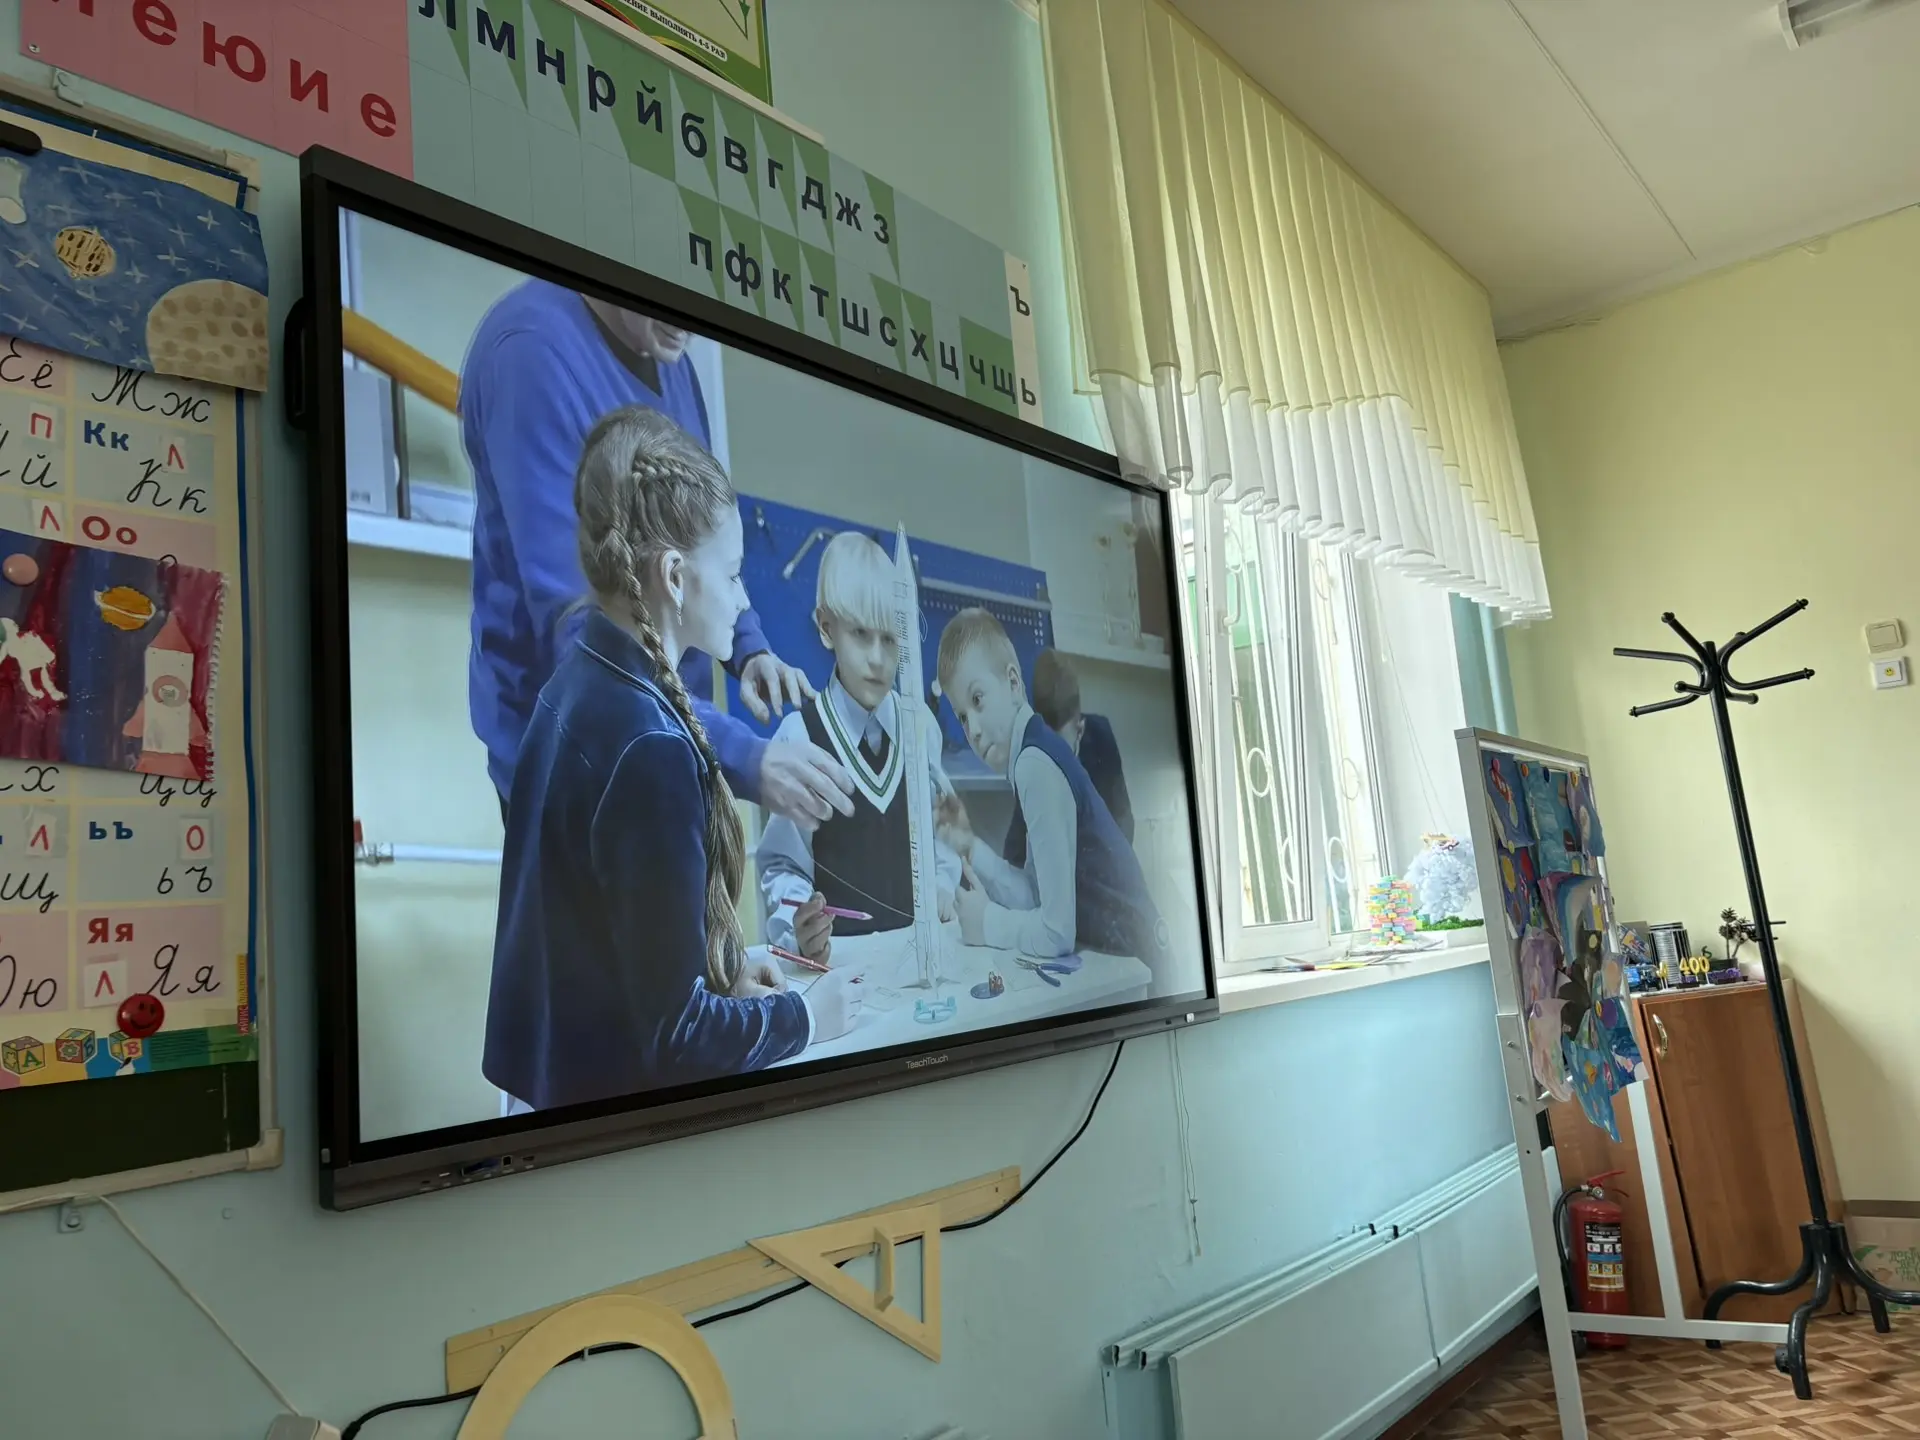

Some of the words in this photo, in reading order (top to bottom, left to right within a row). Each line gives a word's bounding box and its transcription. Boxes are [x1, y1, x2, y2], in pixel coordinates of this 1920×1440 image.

[360, 93, 396, 138] е
[476, 7, 516, 61] м
[536, 38, 566, 86] н
[587, 64, 616, 113] р
[636, 79, 663, 134] й
[680, 112, 708, 158] б
[724, 136, 748, 174] в
[767, 157, 783, 189] г
[802, 176, 827, 220] д
[835, 191, 862, 231] ж
[689, 232, 713, 271] п
[725, 242, 761, 297] ф
[773, 268, 793, 305] к
[810, 284, 829, 318] т
[841, 298, 869, 336] ш
[879, 316, 897, 347] с
[910, 328, 929, 362] х
[939, 341, 959, 380] ц
[969, 354, 985, 385] ч
[992, 365, 1016, 404] щ
[905, 1054, 949, 1069] TeachTouch
